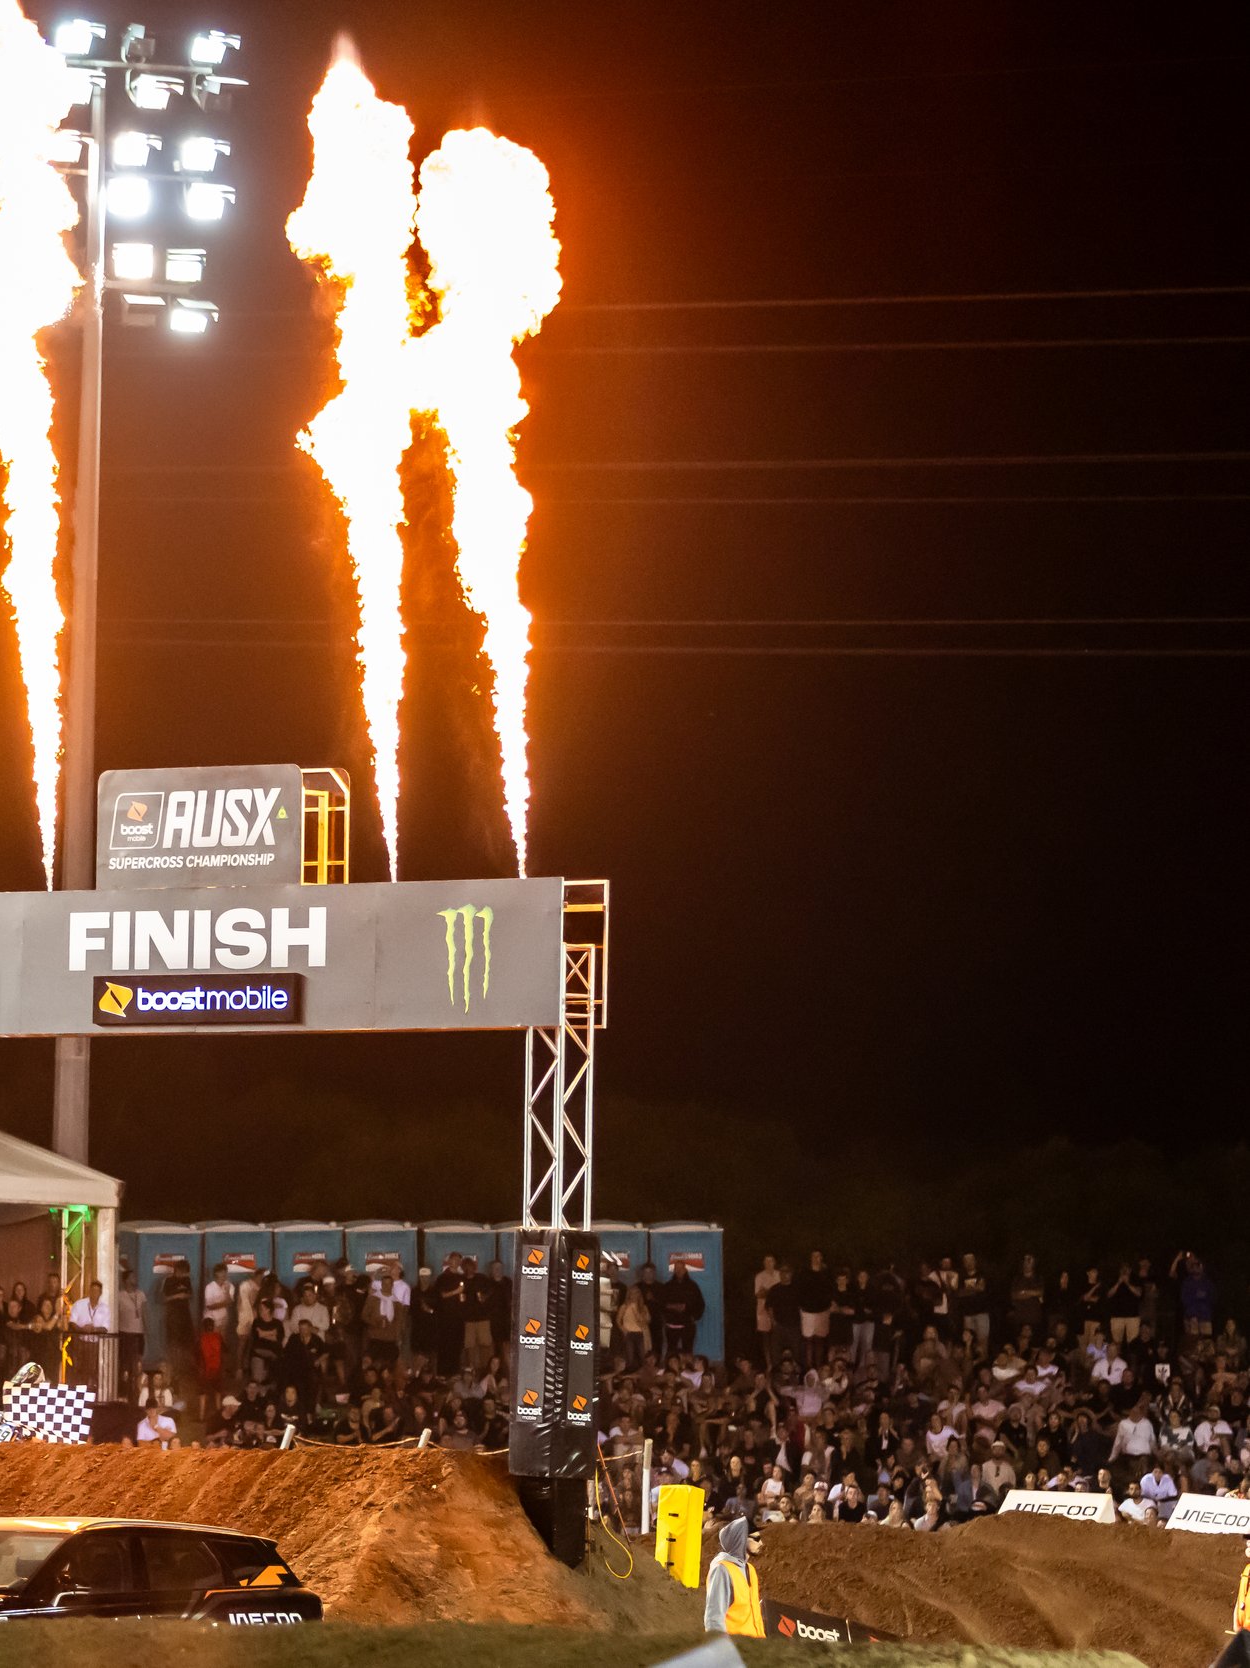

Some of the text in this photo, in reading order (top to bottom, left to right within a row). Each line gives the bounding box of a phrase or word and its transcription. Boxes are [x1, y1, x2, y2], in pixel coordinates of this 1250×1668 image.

[163, 788, 281, 848] AUSX
[120, 823, 154, 836] boost
[109, 853, 275, 870] SUPERCROSS CHAMPIONSHIP
[69, 907, 327, 971] FINISH
[521, 1265, 548, 1275] boost
[571, 1270, 594, 1281] boost
[519, 1335, 546, 1345] boost
[570, 1340, 594, 1351] boost
[517, 1406, 543, 1416] boost
[567, 1411, 592, 1422] boost
[1175, 1509, 1250, 1527] JAECOO
[796, 1619, 840, 1641] boost
